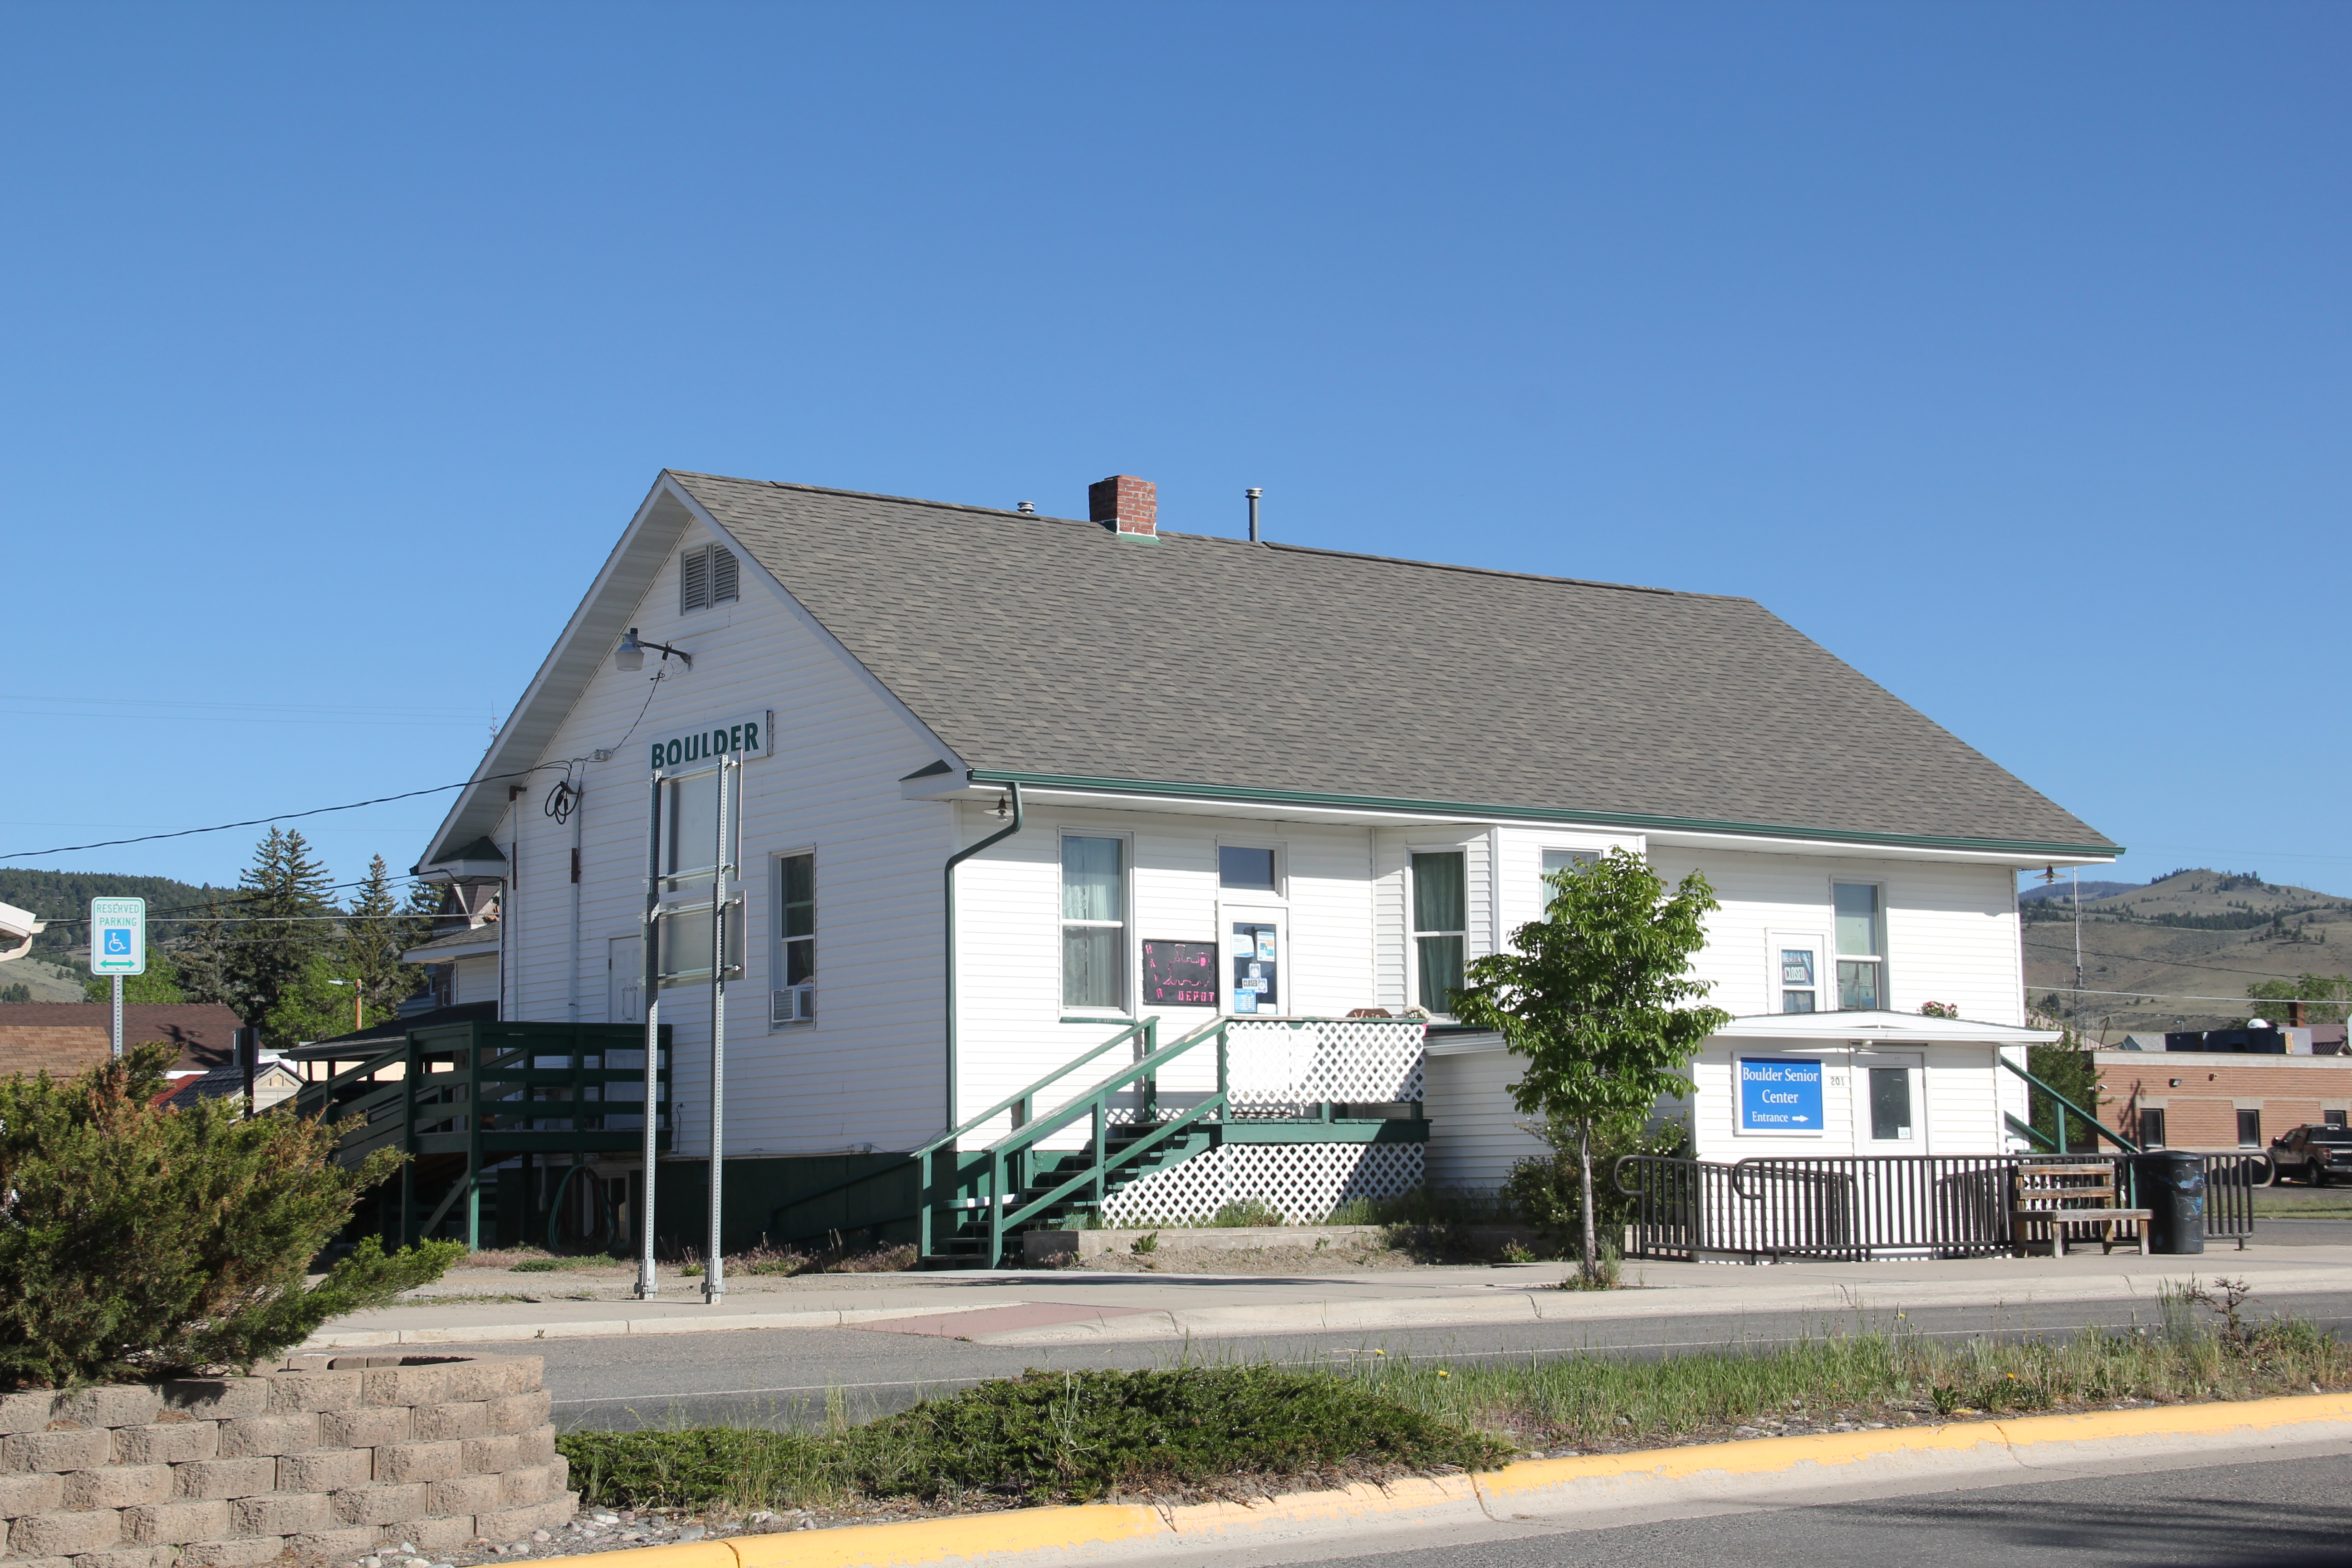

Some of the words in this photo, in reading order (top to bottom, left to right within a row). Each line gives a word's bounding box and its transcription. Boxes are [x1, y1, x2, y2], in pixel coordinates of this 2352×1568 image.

[651, 722, 760, 769] BOULDER
[96, 904, 139, 913] RESERVED
[99, 917, 137, 926] PARKING
[1784, 966, 1805, 981] CLOSED
[1178, 990, 1214, 1002] DEPOT
[1743, 1067, 1783, 1081] Boulder
[1785, 1068, 1818, 1082] Senior
[1830, 1077, 1845, 1086] 201
[1762, 1089, 1798, 1103] Center
[1752, 1111, 1788, 1122] Entrance
